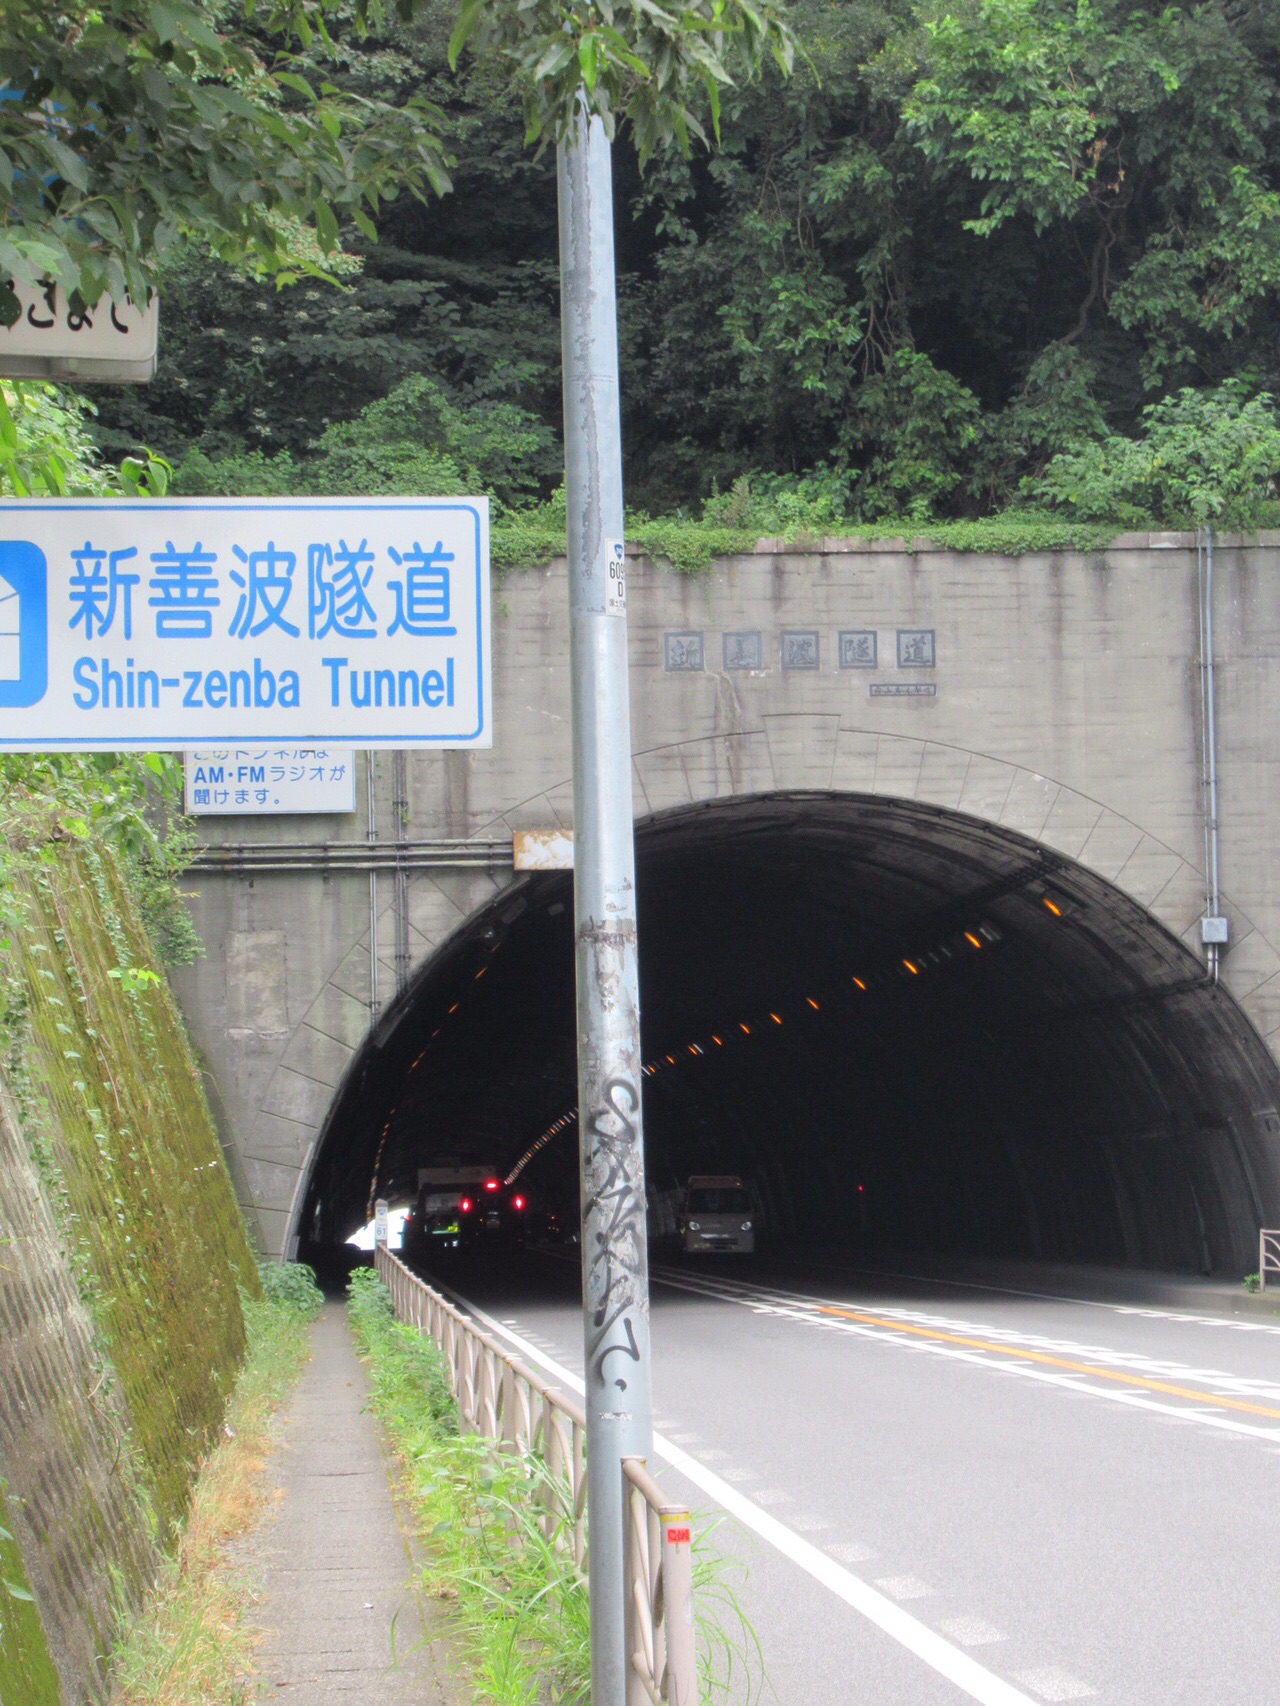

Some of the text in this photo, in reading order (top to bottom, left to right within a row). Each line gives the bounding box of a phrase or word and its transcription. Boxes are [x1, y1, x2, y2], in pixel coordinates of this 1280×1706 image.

[68, 539, 457, 641] 新善波隧道
[73, 657, 455, 710] Shin-zenba Tunnel
[193, 788, 280, 805] 聞けます。
